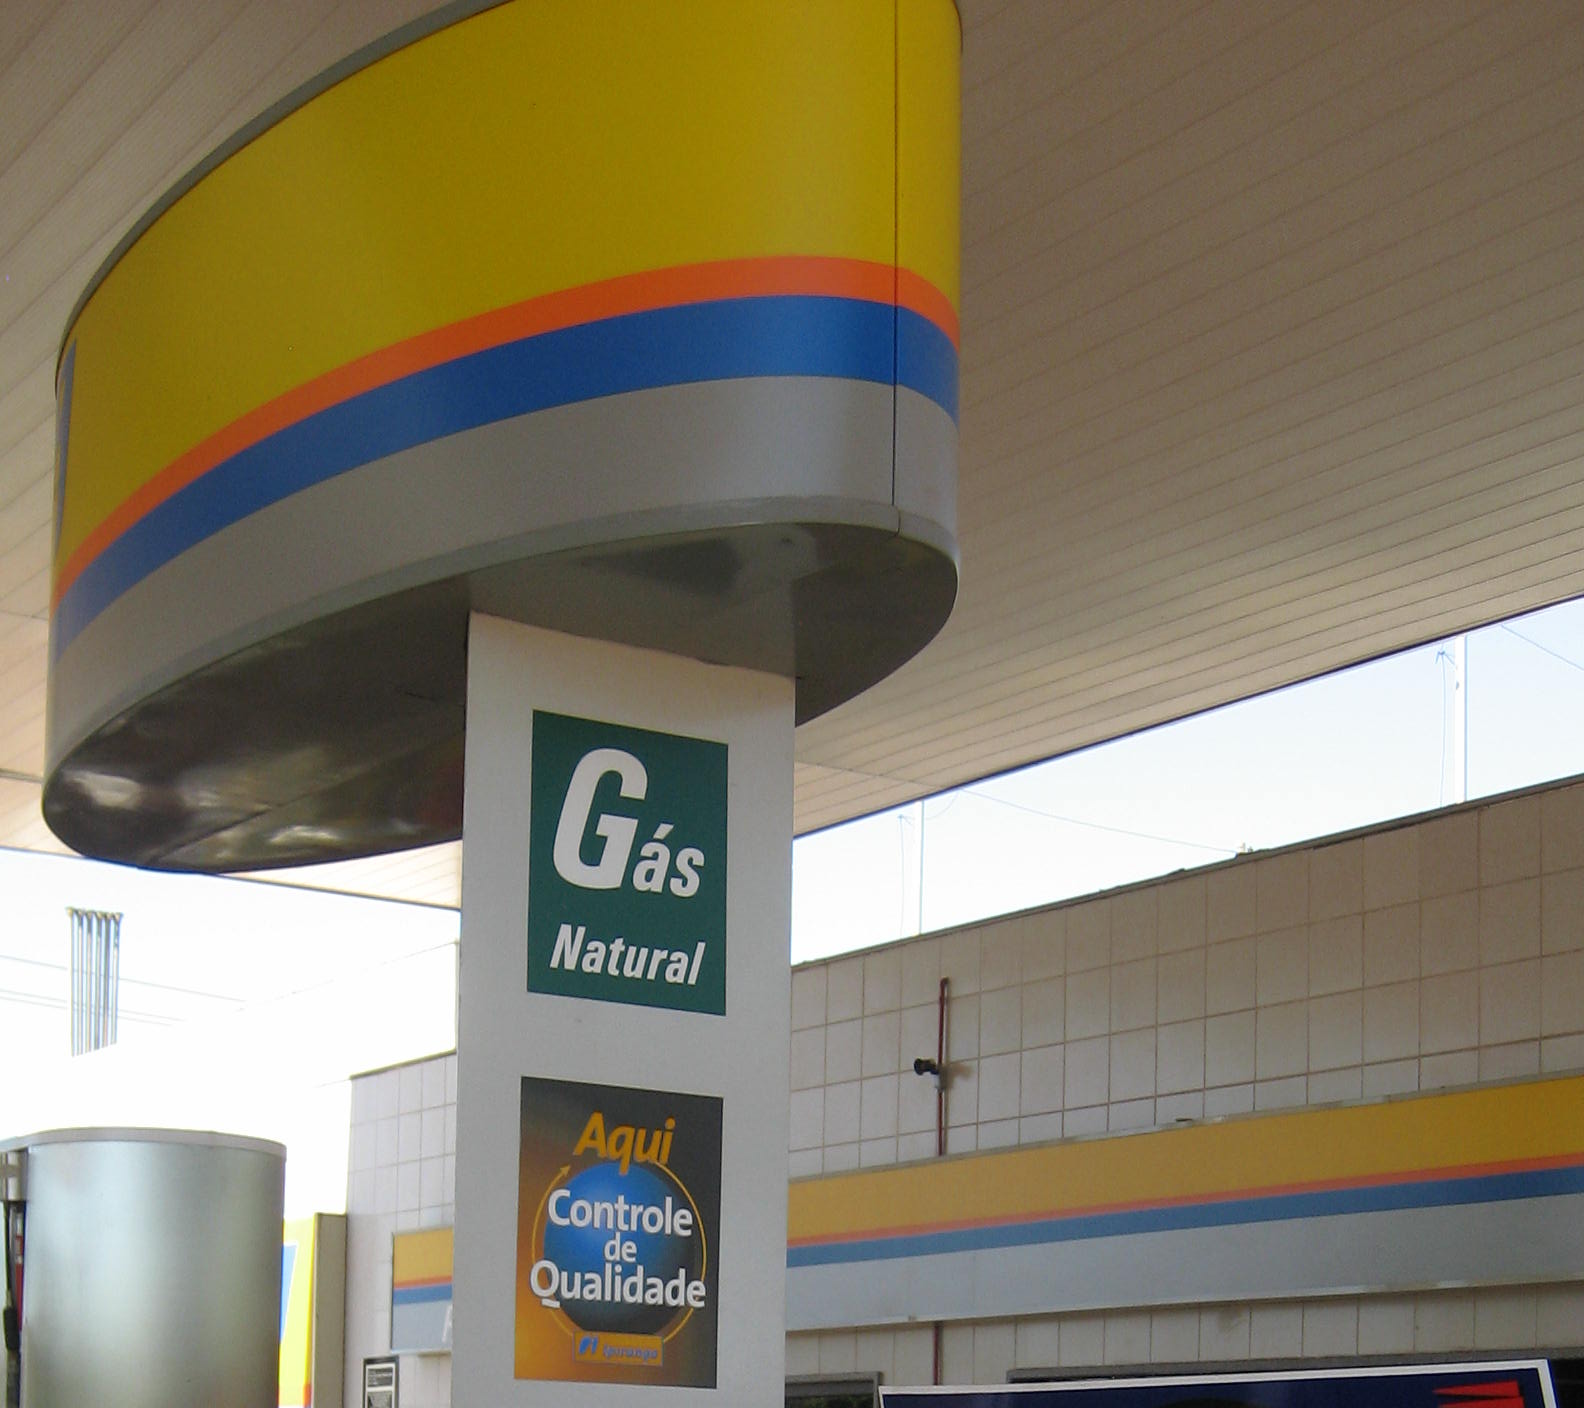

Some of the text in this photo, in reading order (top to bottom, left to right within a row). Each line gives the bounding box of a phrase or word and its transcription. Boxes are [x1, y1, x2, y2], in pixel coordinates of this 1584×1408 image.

[553, 747, 705, 898] Gás
[550, 923, 706, 986] Natural
[573, 1110, 676, 1176] Aqui
[548, 1188, 693, 1236] Controle
[604, 1232, 637, 1263] de
[530, 1259, 706, 1309] Qualidade
